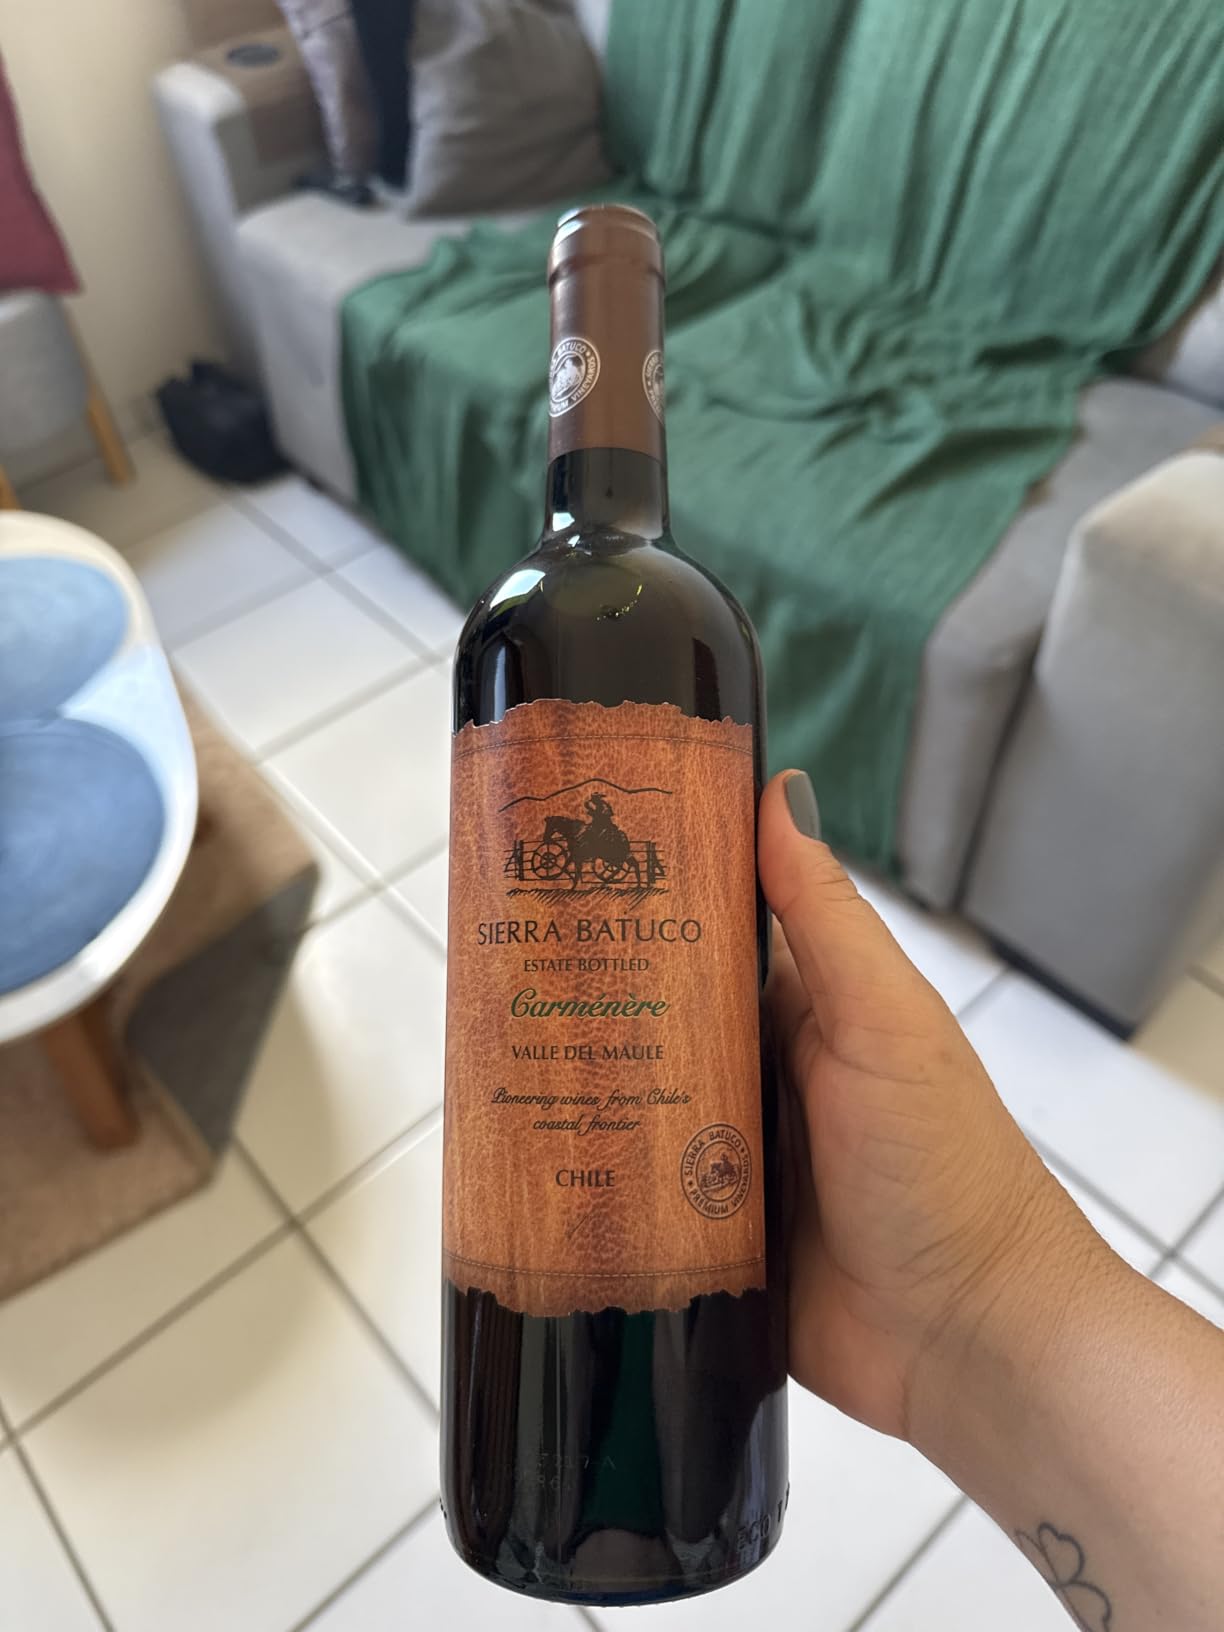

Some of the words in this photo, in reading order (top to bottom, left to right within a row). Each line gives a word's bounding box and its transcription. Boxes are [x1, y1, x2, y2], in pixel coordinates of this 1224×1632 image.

[477, 920, 562, 945] SIERRA
[577, 918, 702, 943] BATUCO
[524, 958, 572, 972] ESTATE
[578, 958, 649, 972] BOTTLED
[510, 988, 669, 1018] Carménère
[512, 1045, 558, 1060] VALLE
[565, 1045, 596, 1060] DEL
[602, 1045, 664, 1060] MAULE
[491, 1087, 558, 1110] Pioneering
[558, 1091, 600, 1106] wines
[598, 1089, 641, 1110] from
[646, 1087, 691, 1105] Chile's
[533, 1114, 581, 1131] coastal
[579, 1117, 640, 1136] frontier
[685, 1139, 705, 1176] SIERRA
[709, 1130, 742, 1149] BATUCO
[555, 1169, 616, 1187] CHILE
[690, 1188, 729, 1215] PREMIUM
